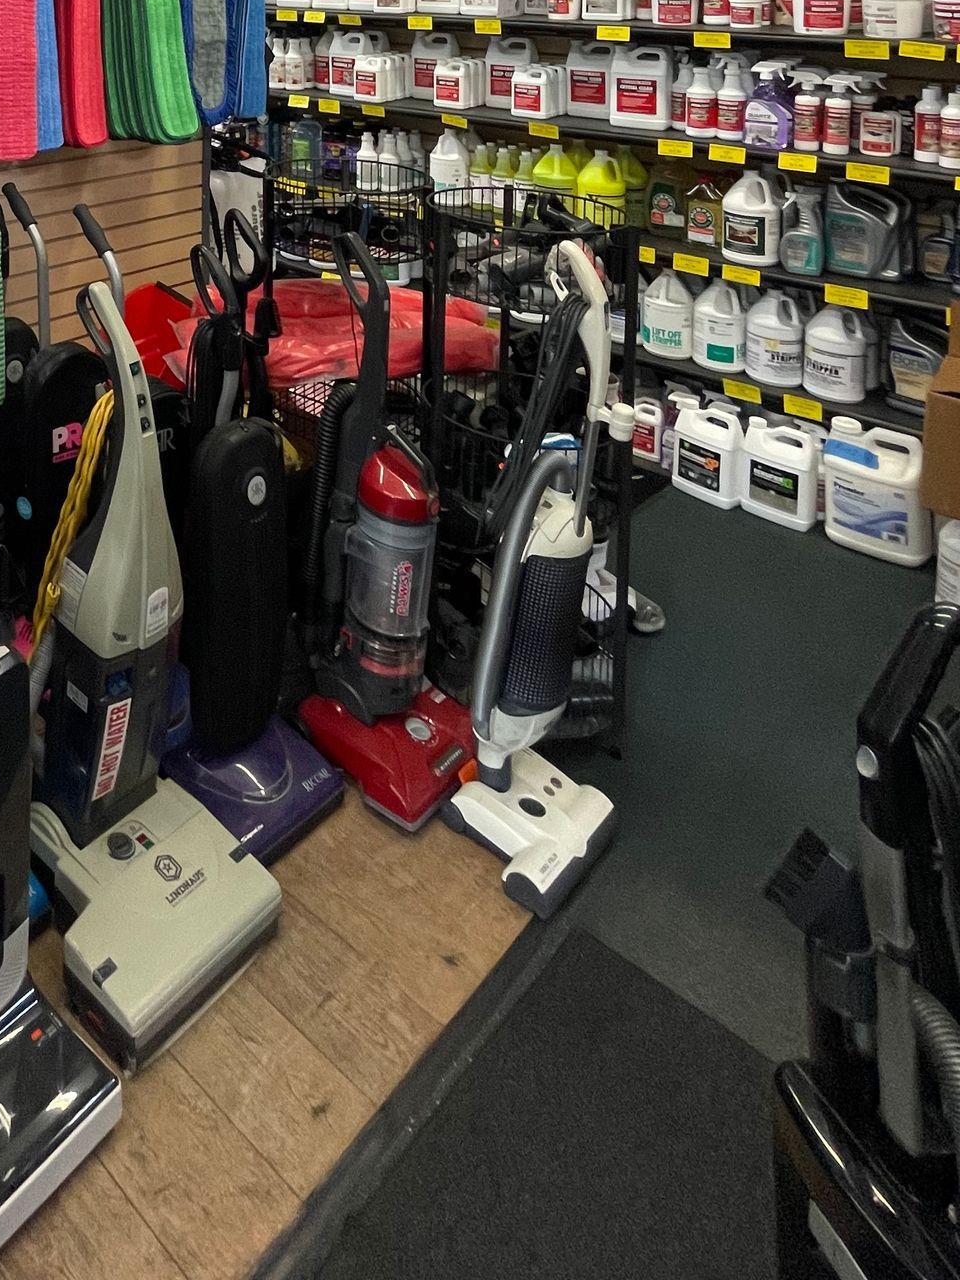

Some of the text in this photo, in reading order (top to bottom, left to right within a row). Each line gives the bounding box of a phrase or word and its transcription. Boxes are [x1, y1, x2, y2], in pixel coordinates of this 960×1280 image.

[652, 327, 683, 339] LIFT OFF
[805, 360, 840, 376] STRIPPER
[95, 702, 129, 798] NO HOT WATER
[164, 868, 205, 904] LINDHAUS
